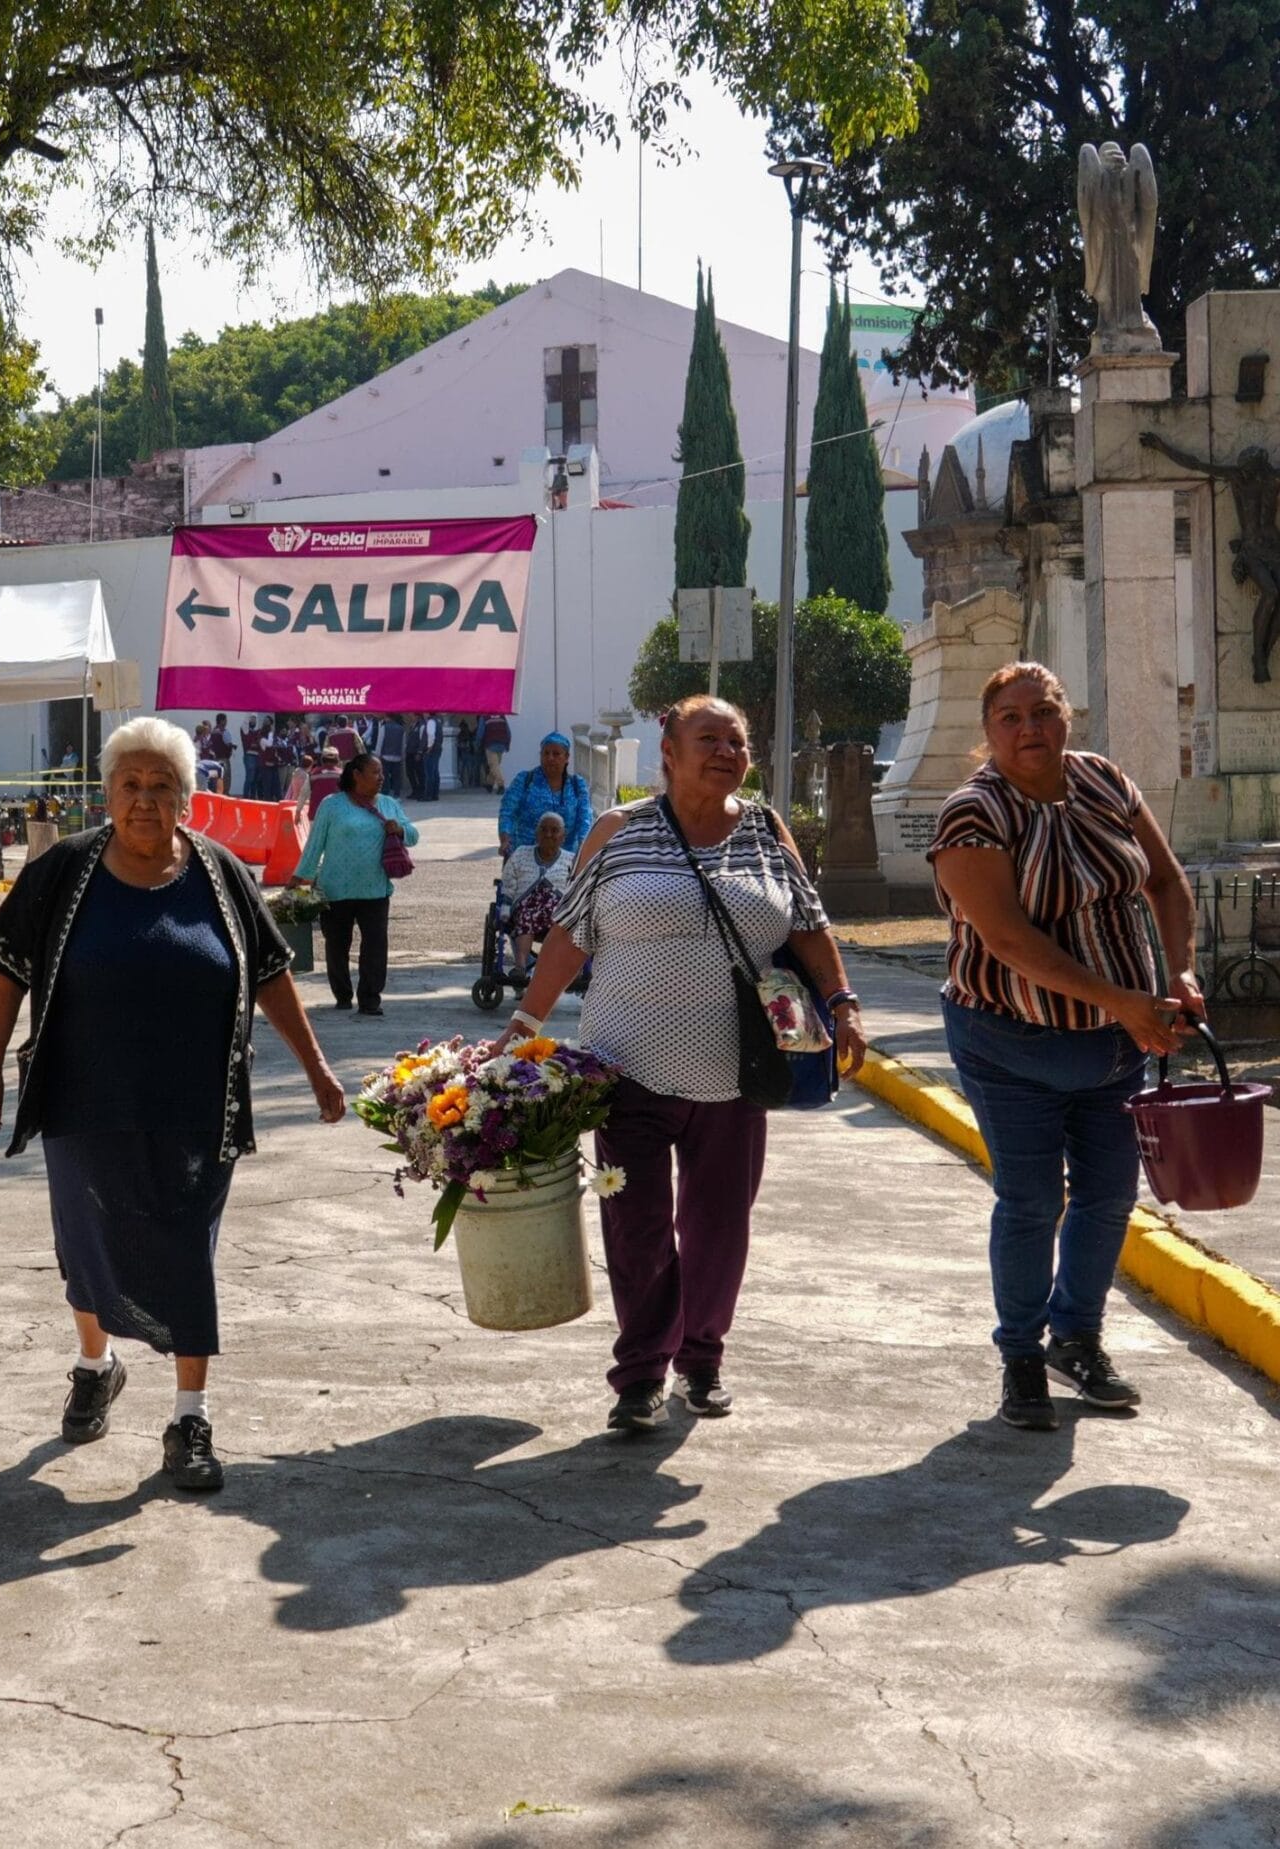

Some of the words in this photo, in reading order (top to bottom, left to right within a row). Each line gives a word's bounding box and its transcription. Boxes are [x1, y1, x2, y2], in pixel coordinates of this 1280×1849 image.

[311, 531, 366, 546] Puebla
[373, 537, 424, 545] IMPARABLE
[251, 580, 517, 634] SALIDA
[303, 695, 366, 705] IMPARABLE
